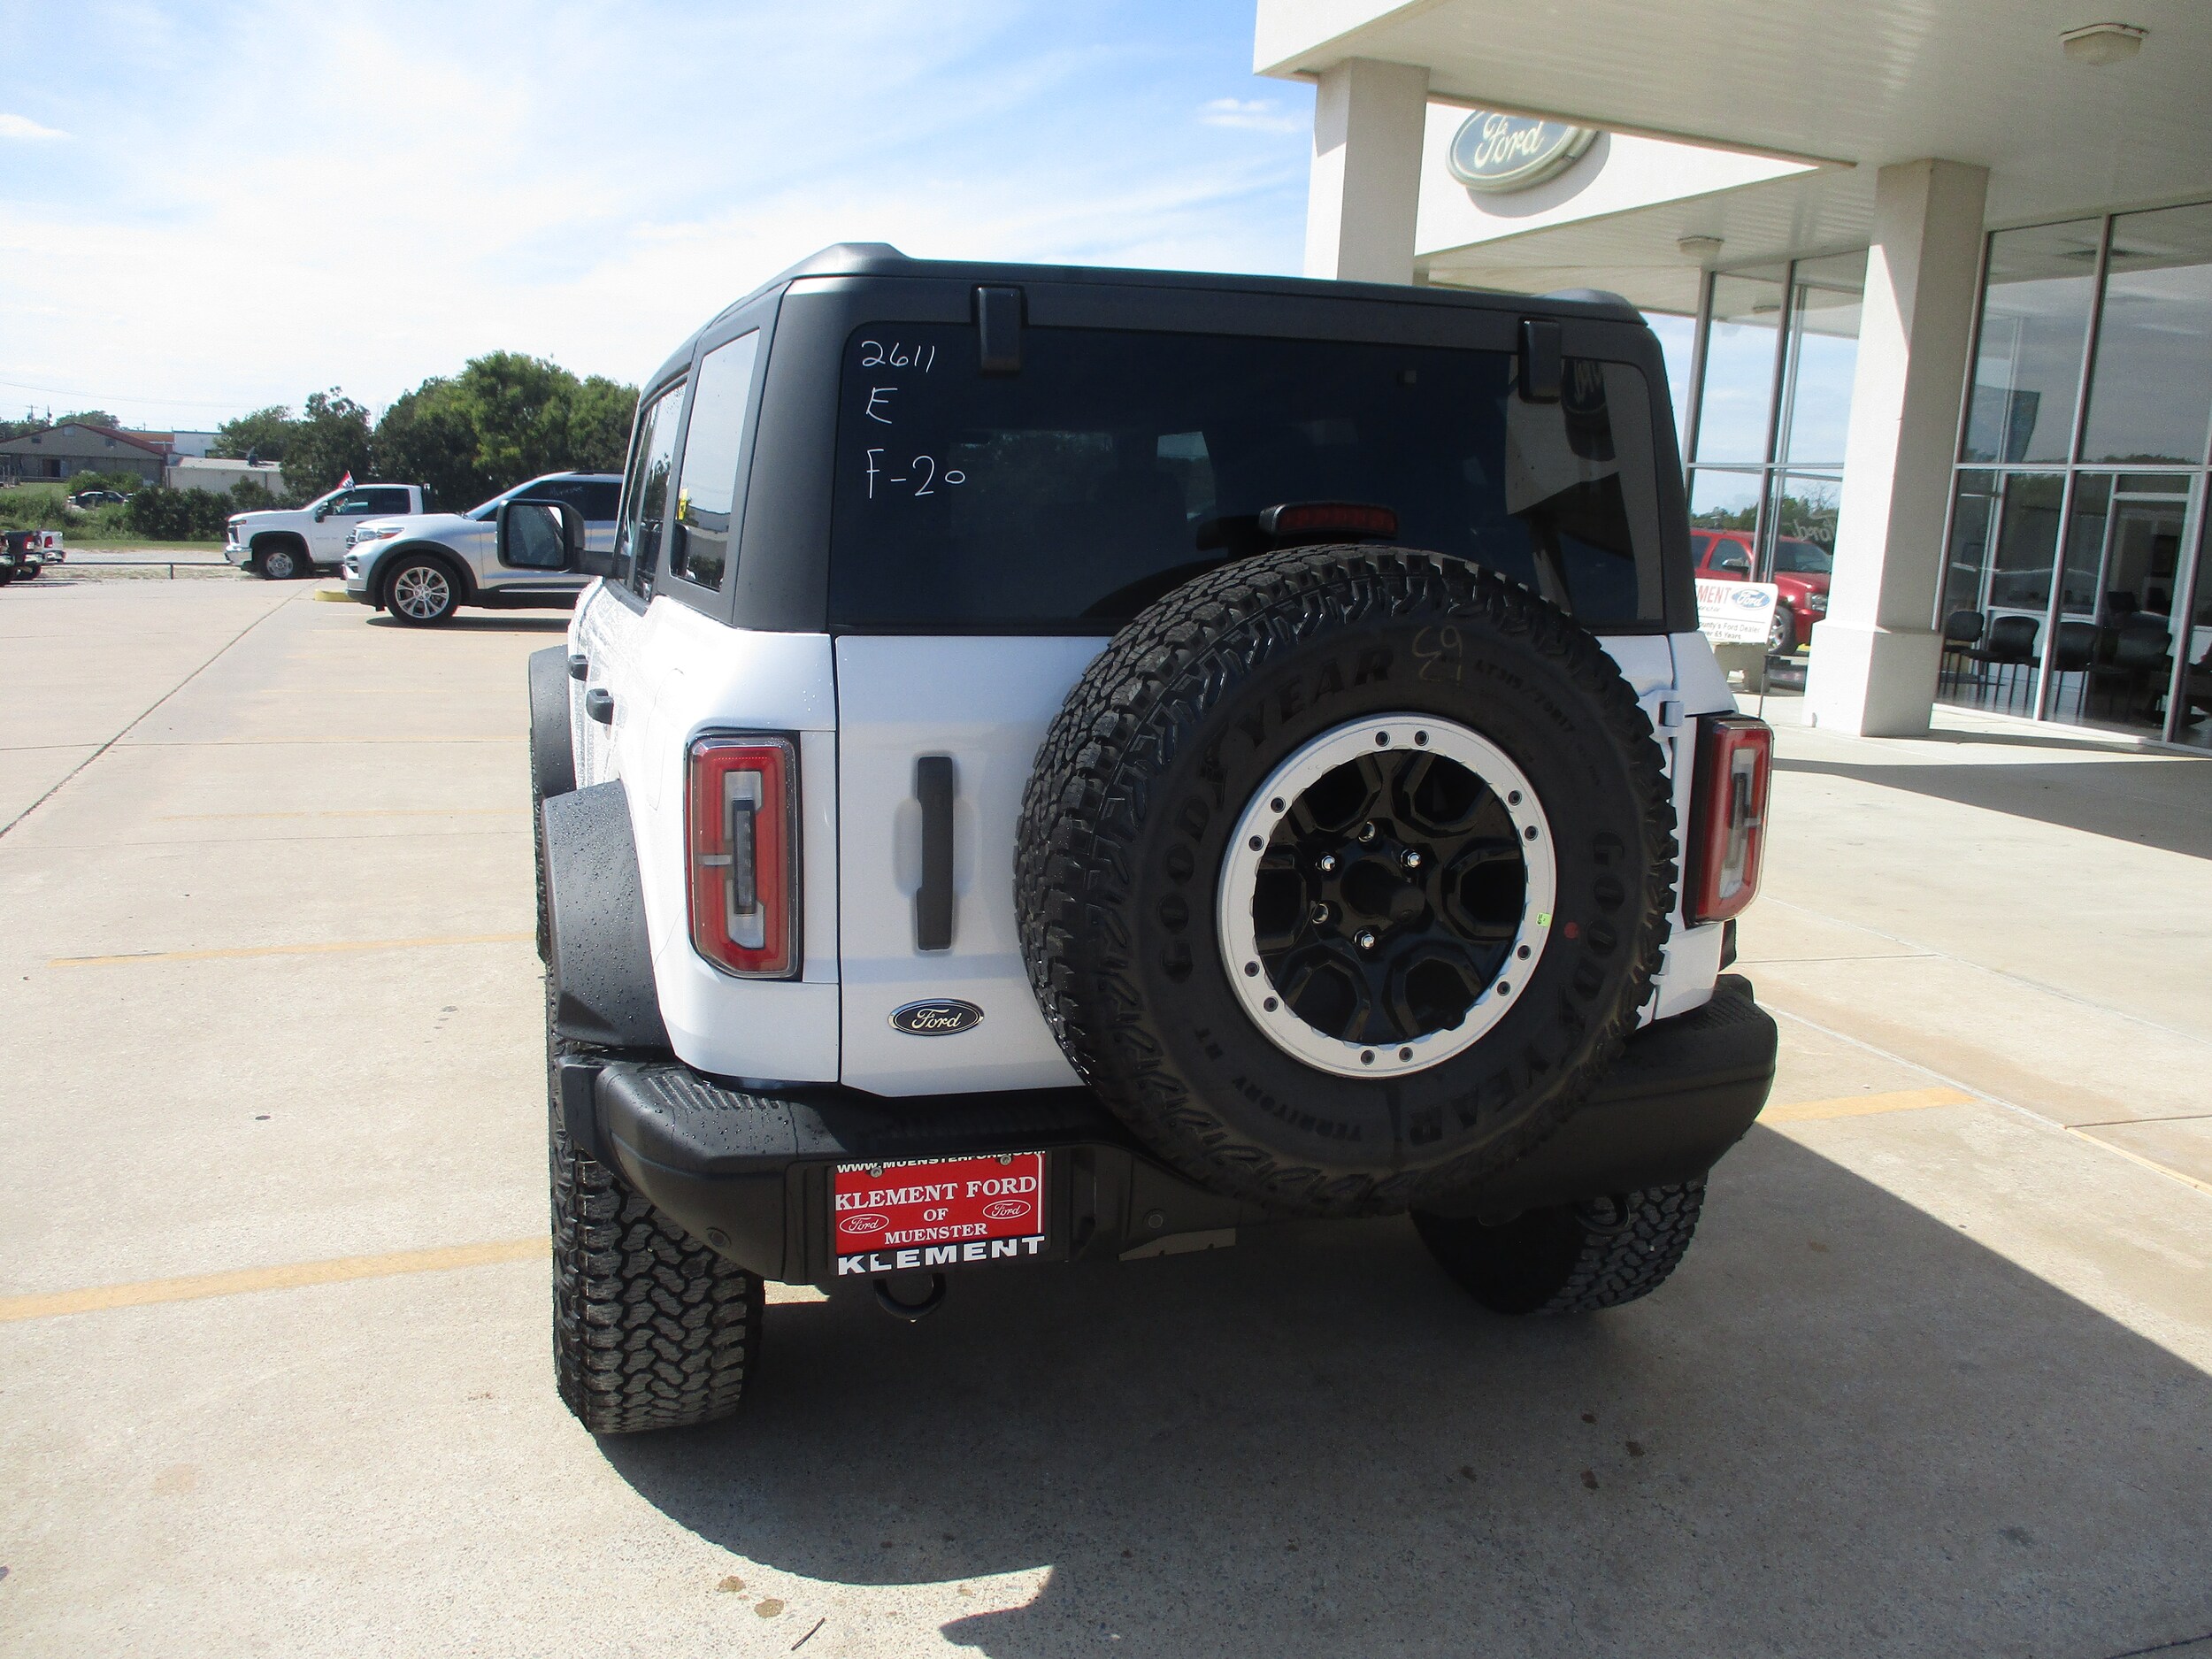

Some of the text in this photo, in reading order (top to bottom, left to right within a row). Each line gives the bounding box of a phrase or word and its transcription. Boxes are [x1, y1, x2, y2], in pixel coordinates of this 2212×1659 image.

[1474, 111, 1546, 169] Ford
[861, 340, 936, 373] 2611
[865, 387, 899, 424] E
[1696, 585, 1767, 607] MENT Ford
[911, 1008, 963, 1029] Ford
[835, 1175, 1037, 1211] KLEMENT FORD
[923, 1207, 949, 1222] OF
[991, 1204, 1022, 1217] Ford
[848, 1217, 879, 1232] Ford
[884, 1223, 988, 1245] MUENSTER
[838, 1235, 1046, 1276] KLEMENT
